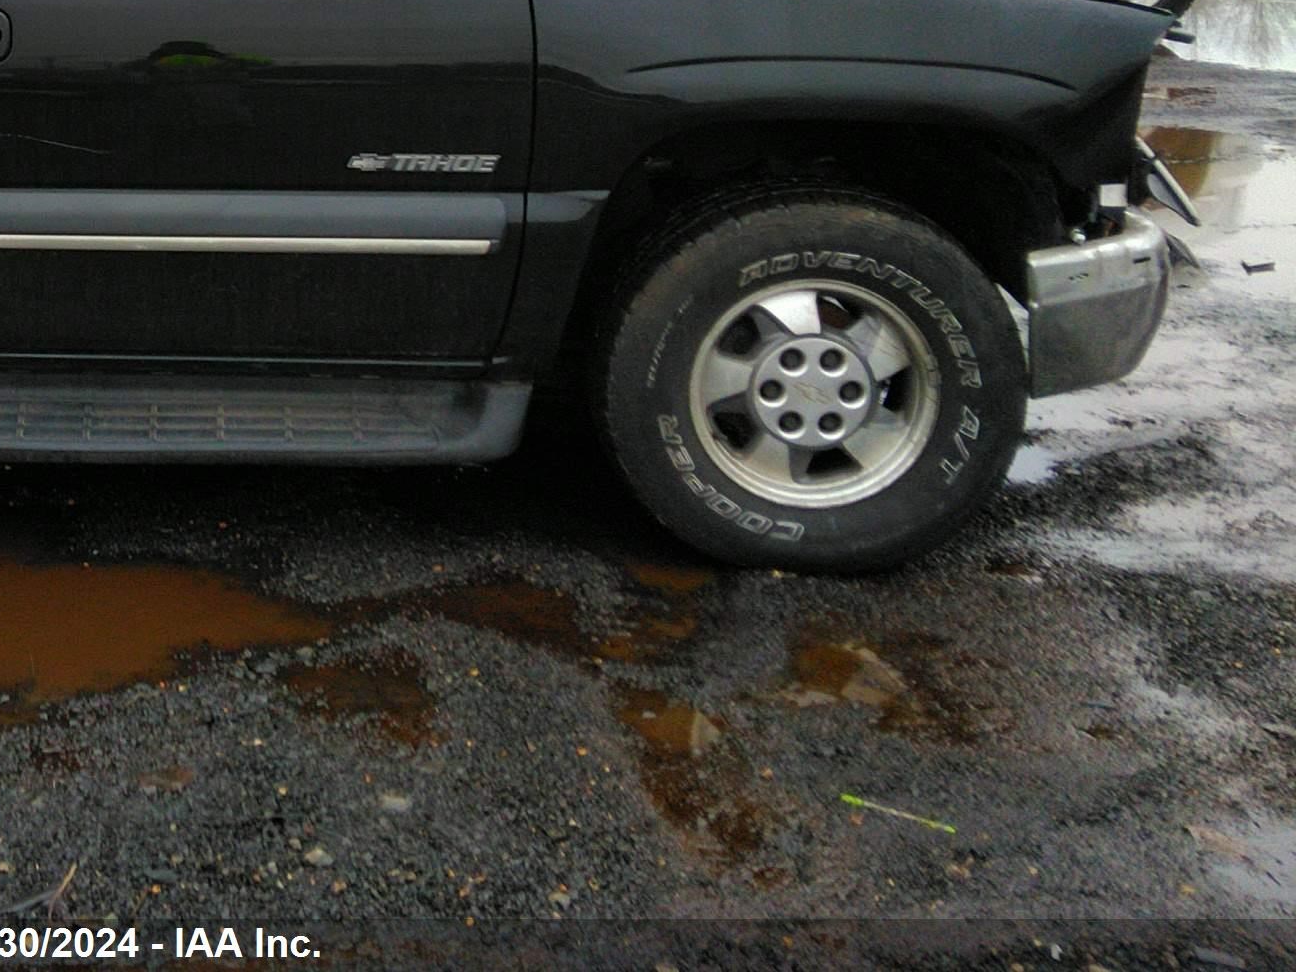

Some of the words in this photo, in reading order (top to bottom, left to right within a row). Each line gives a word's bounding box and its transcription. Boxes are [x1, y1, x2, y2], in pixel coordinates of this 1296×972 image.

[392, 153, 502, 173] TAHOE
[739, 250, 984, 389] ADVENTURER
[939, 404, 981, 485] A/T
[657, 412, 805, 542] COOPER
